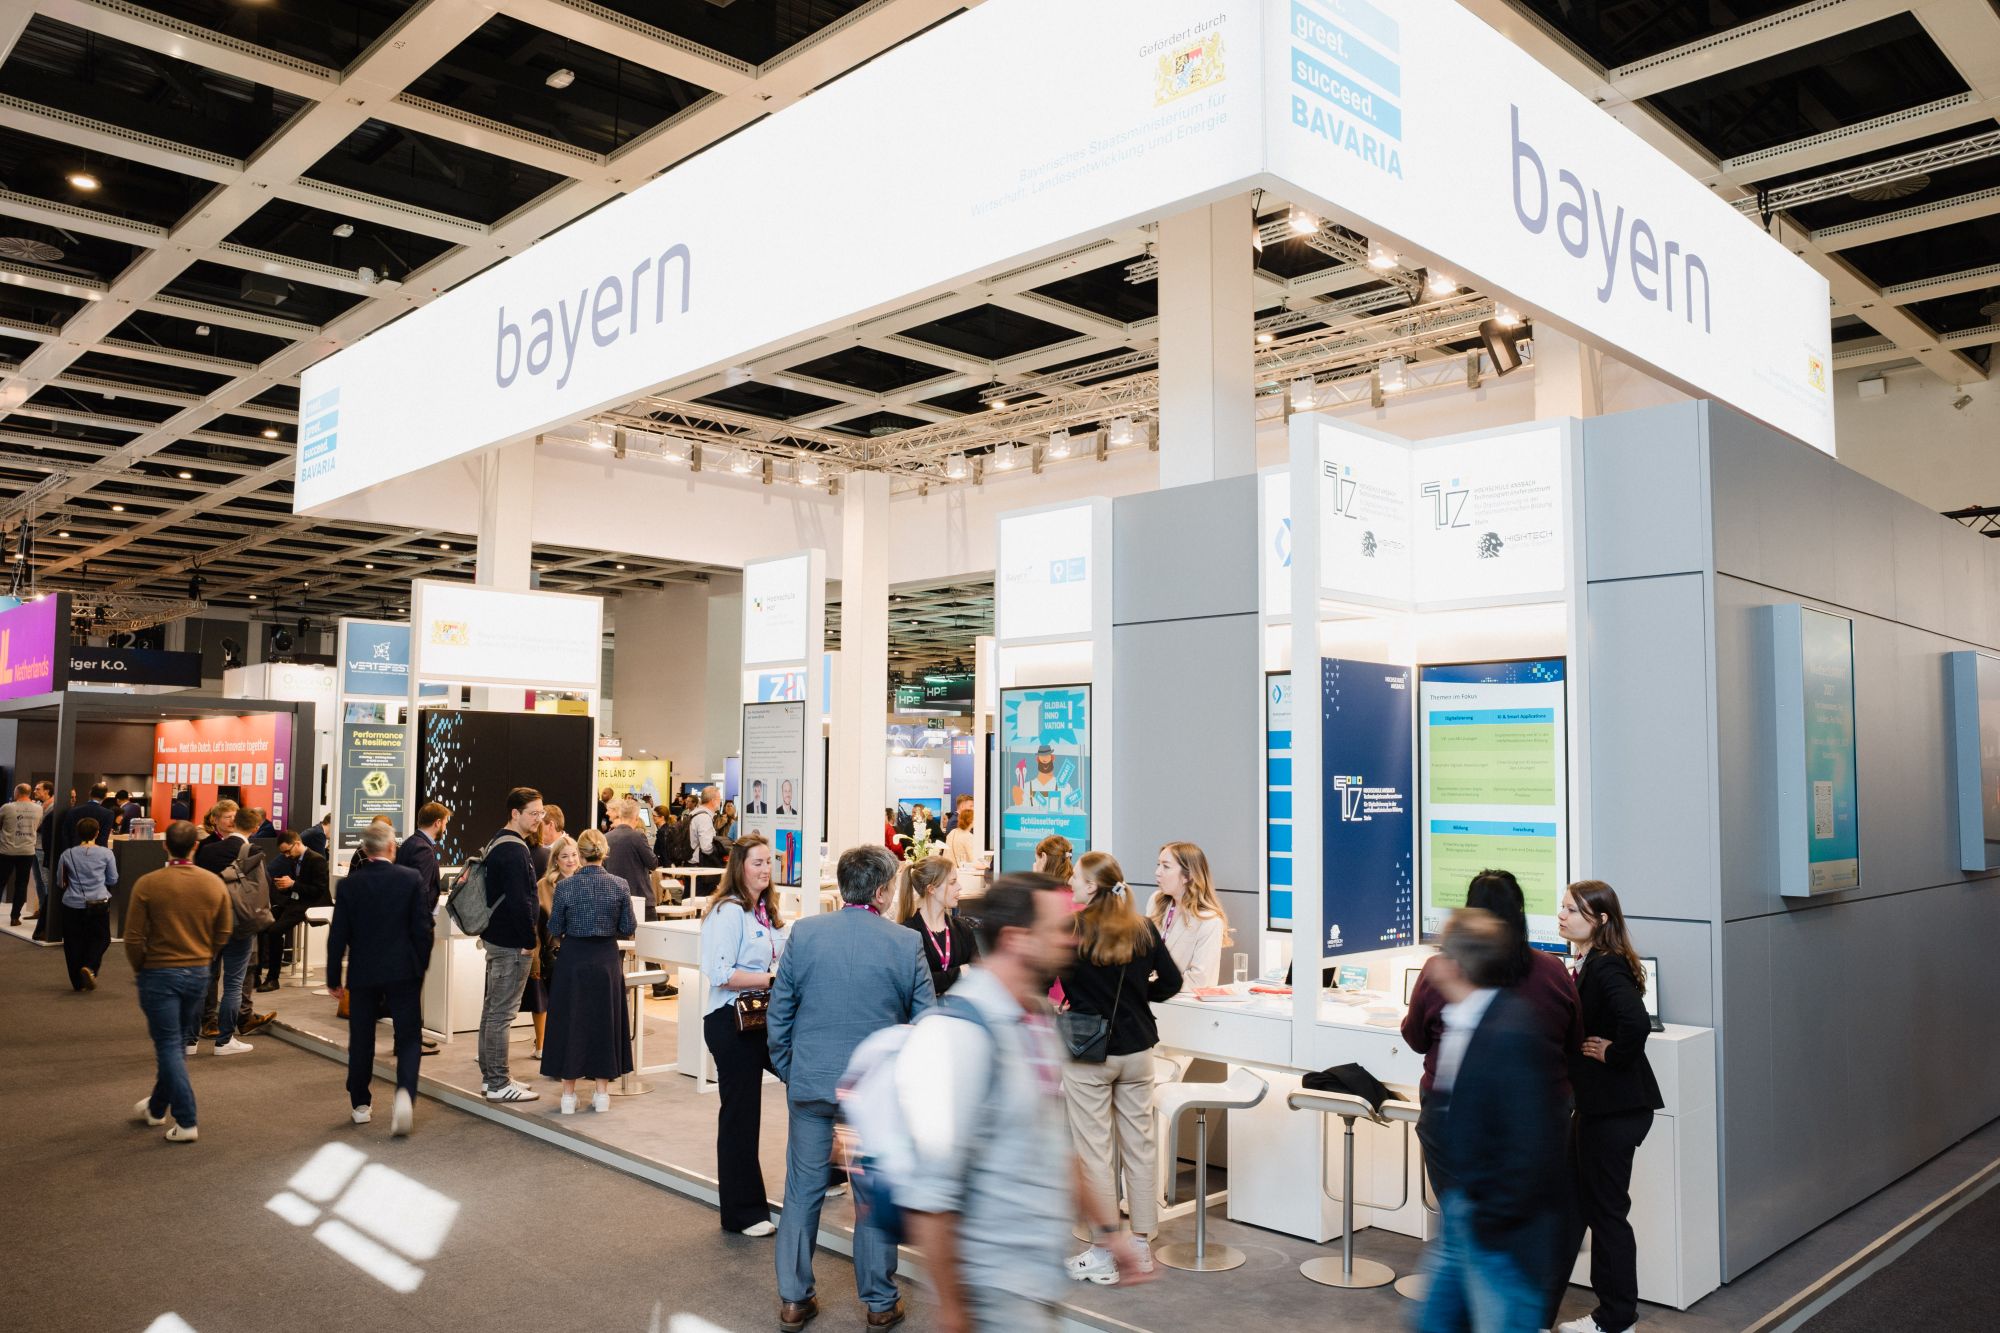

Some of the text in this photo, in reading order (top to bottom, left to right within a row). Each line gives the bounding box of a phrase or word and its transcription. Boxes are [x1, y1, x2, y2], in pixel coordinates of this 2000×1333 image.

[1194, 12, 1227, 35] durch
[1296, 12, 1349, 59] greet.
[1296, 60, 1377, 121] succeed.
[1088, 102, 1203, 154] Staatsministerium
[1208, 91, 1227, 109] für
[1291, 94, 1403, 181] BAVARIA
[1031, 142, 1145, 195] Landesentwicklung
[1148, 131, 1173, 150] und
[1176, 111, 1228, 140] Energie
[1510, 102, 1711, 334] bayern
[496, 242, 691, 391] bayern
[301, 456, 336, 482] BAVARIA
[1504, 531, 1553, 542] HIGHTECH
[15, 655, 49, 681] Netherlands
[101, 659, 128, 671] K.O.
[898, 695, 920, 705] HPE
[926, 686, 948, 697] HPE
[1045, 701, 1067, 710] GLOBAL
[1045, 712, 1059, 720] INNO
[353, 731, 404, 739] Performance
[362, 739, 401, 747] Resilience
[246, 738, 269, 755] together
[597, 769, 636, 778] THE LAND OF
